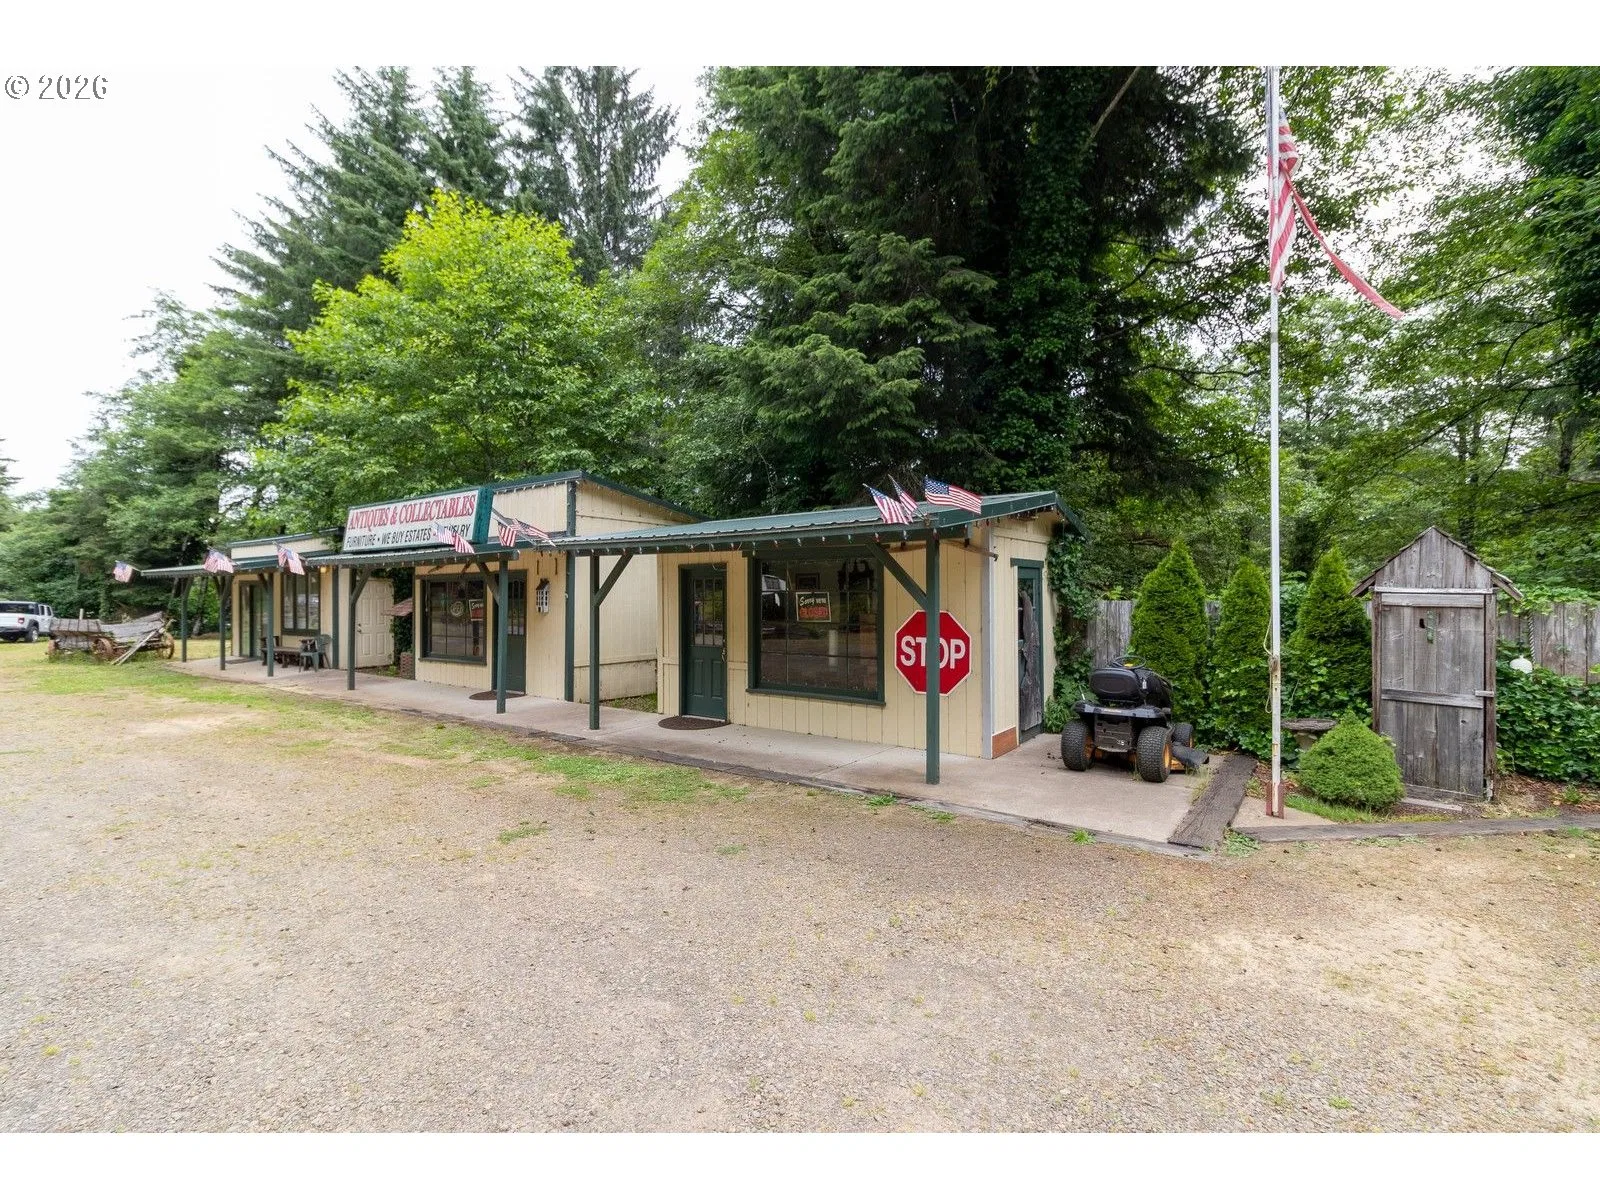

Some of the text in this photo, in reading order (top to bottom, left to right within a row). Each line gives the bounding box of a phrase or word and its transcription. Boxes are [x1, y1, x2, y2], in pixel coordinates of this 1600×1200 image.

[348, 494, 476, 532] ANTIQUES & COLLECTABLES
[347, 534, 376, 547] FURNITURE
[381, 532, 391, 544] WE
[391, 531, 405, 544] BUY
[404, 528, 431, 542] ESTATES
[900, 635, 966, 670] STOP
